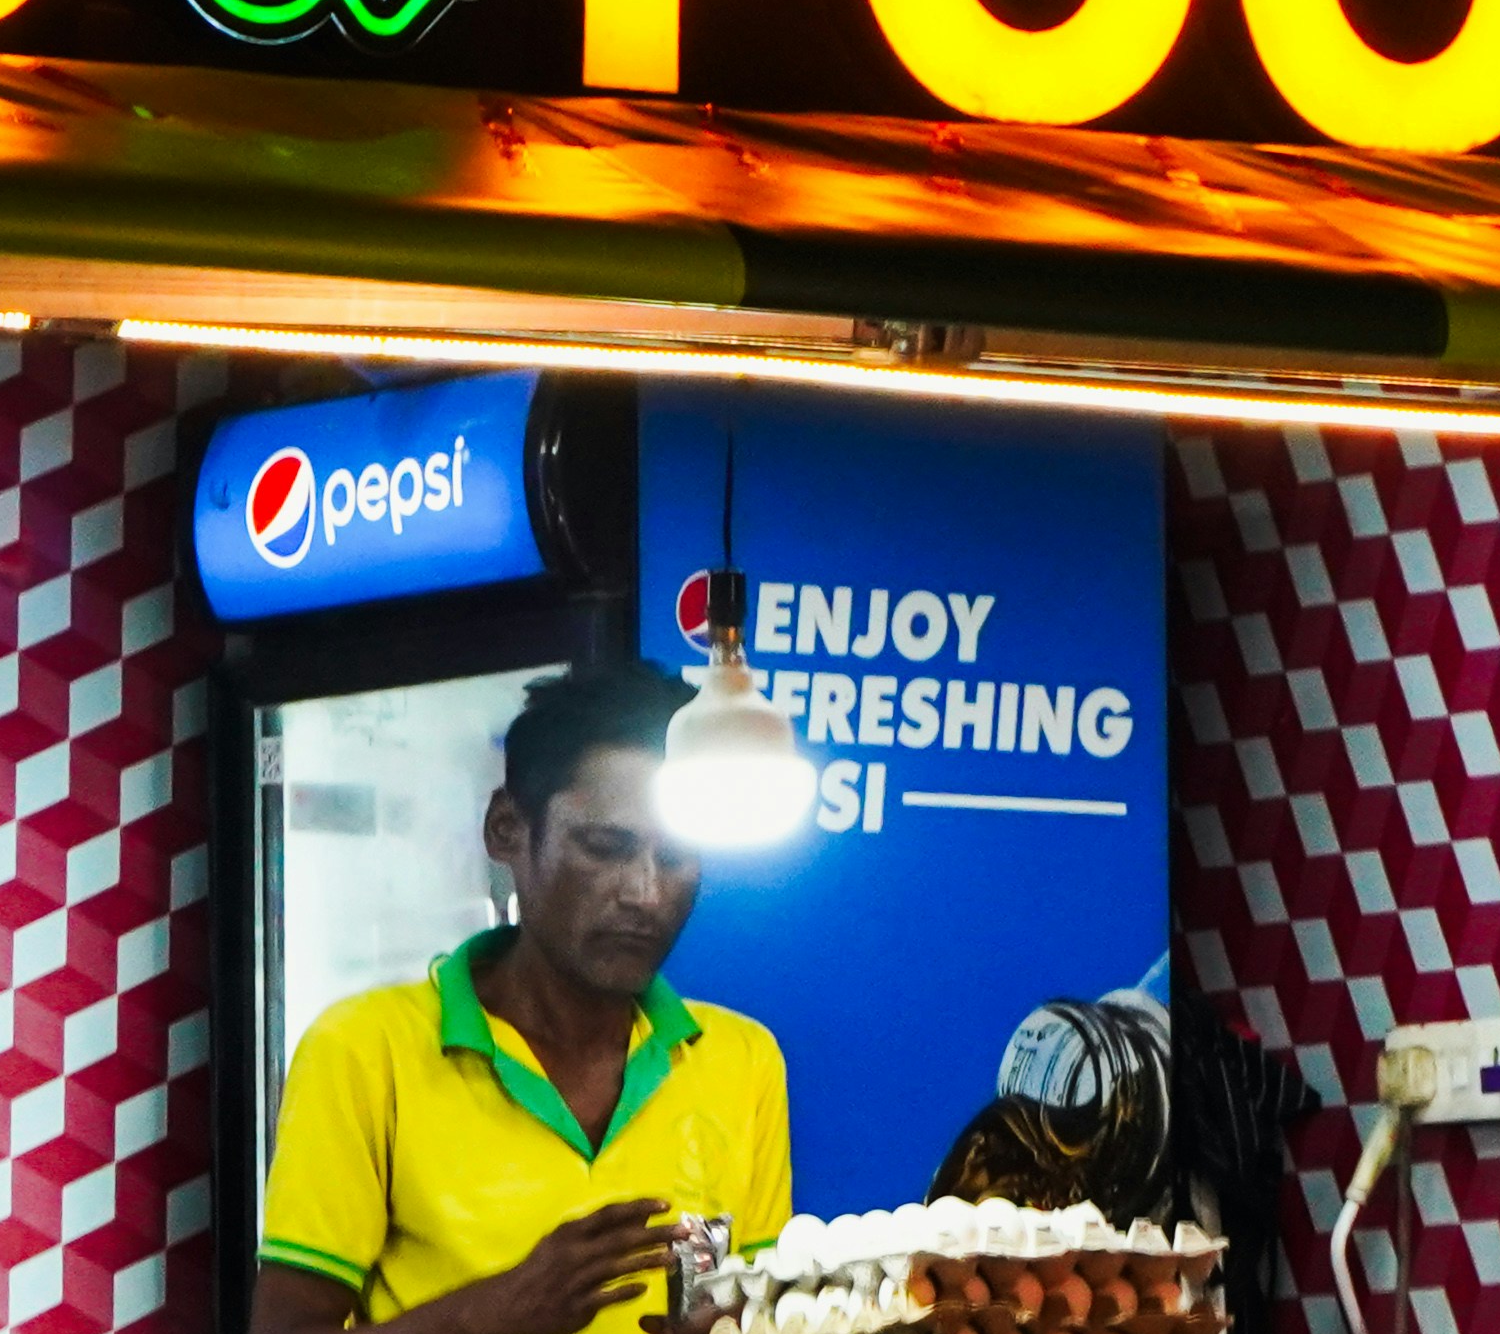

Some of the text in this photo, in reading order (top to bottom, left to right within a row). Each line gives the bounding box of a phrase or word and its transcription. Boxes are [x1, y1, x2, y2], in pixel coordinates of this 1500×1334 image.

[322, 437, 470, 544] pepsi
[753, 581, 996, 662] ENJOY
[681, 665, 1133, 758] FRESHING
